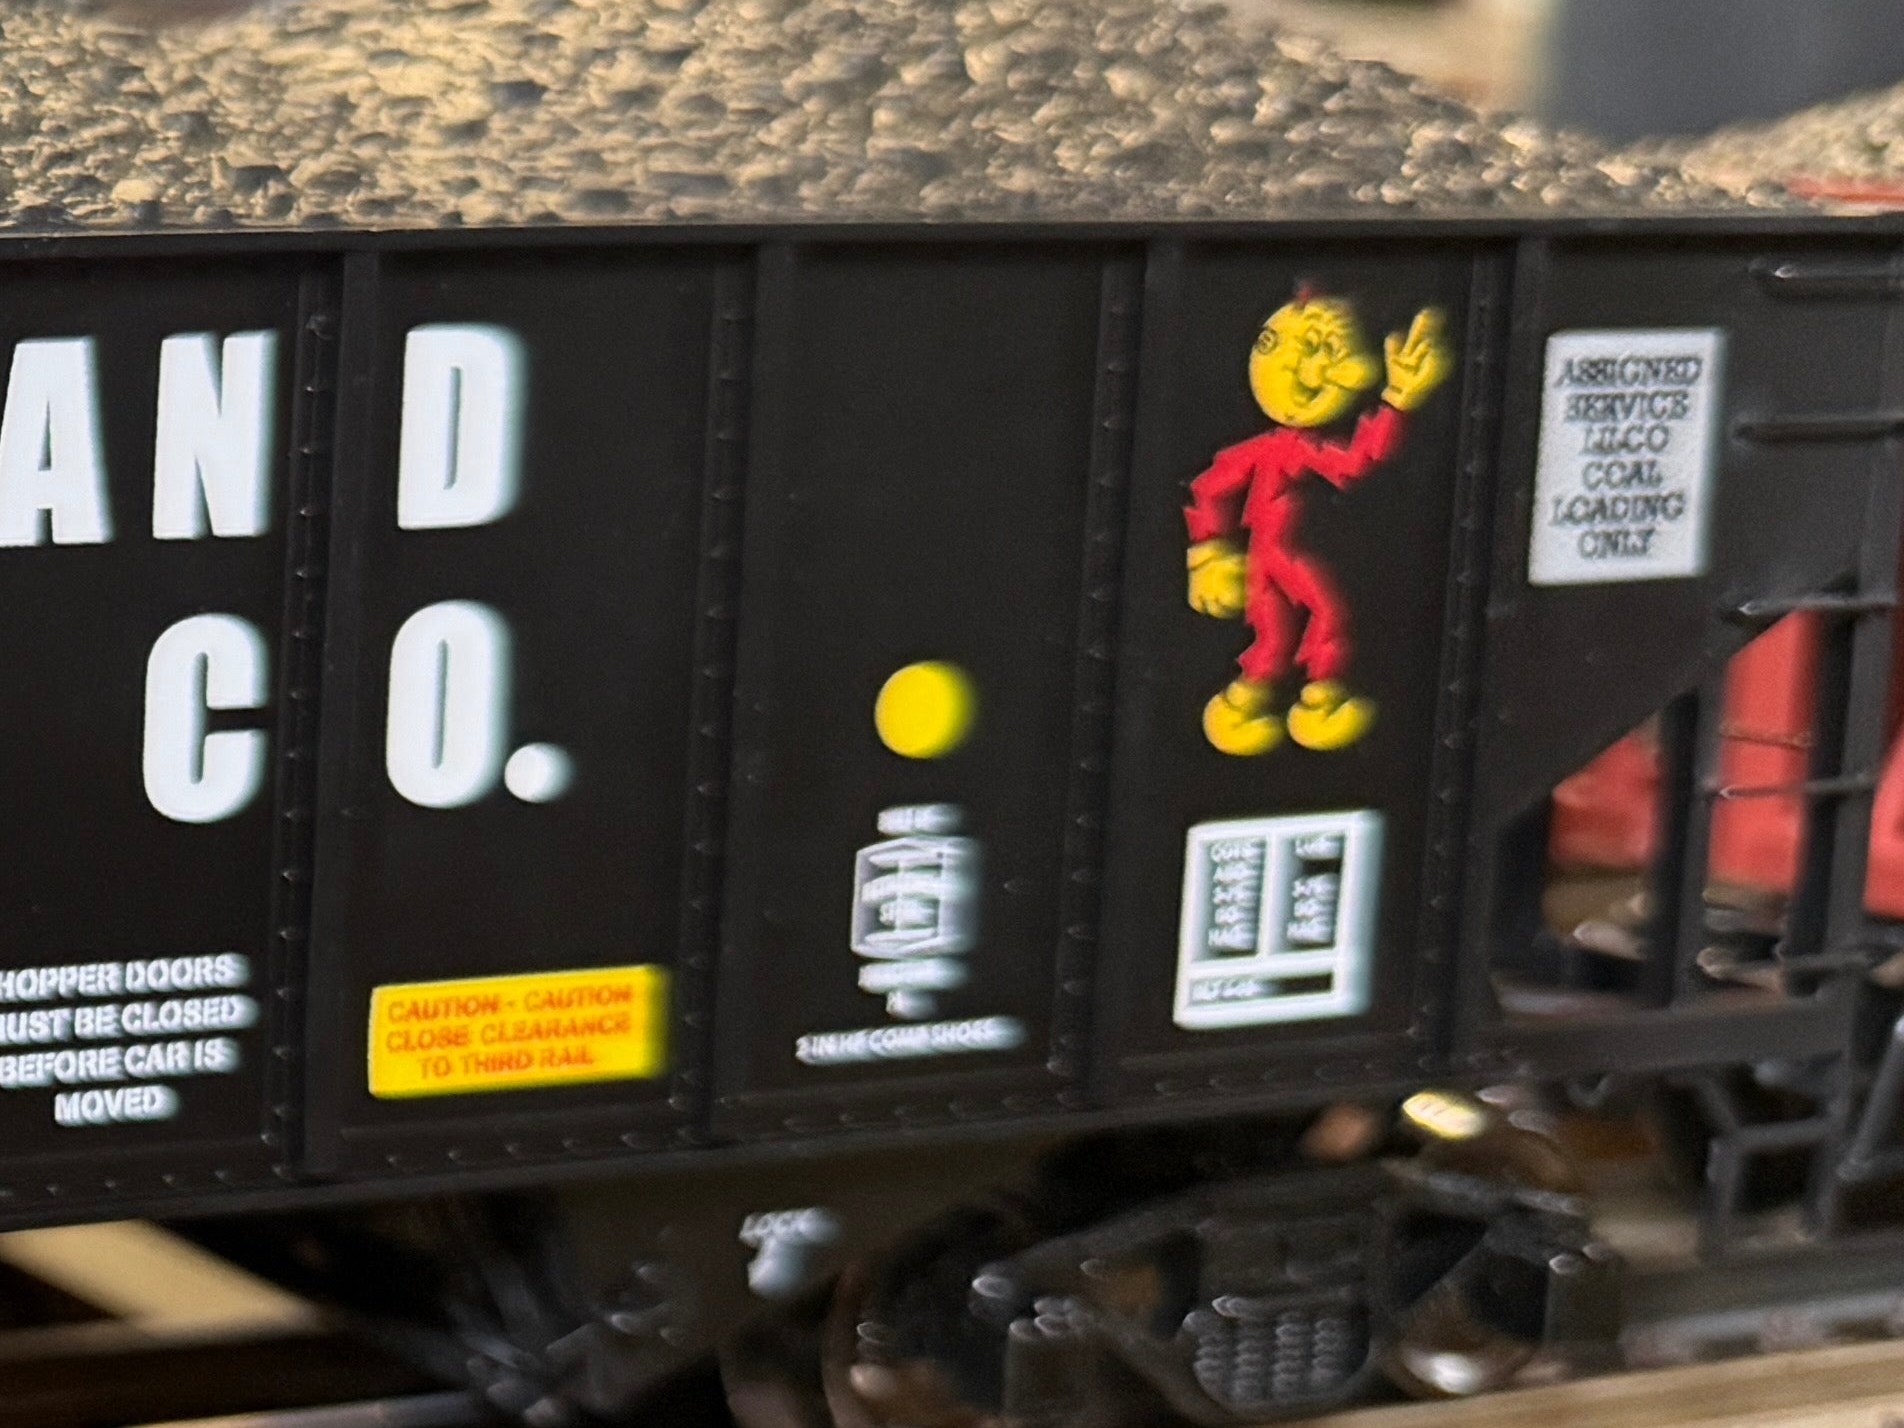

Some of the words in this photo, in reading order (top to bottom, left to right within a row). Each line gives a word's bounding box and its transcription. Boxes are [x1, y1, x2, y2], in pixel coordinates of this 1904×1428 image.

[1553, 356, 1703, 388] ASSIGNED
[1564, 391, 1689, 422] SERVICE
[1581, 459, 1662, 491] COAL
[1548, 492, 1685, 527] LOADING
[1576, 528, 1656, 560] ONLY
[125, 953, 249, 993] DOORS
[75, 1003, 123, 1039] BE
[122, 994, 257, 1035] CLOSED
[388, 993, 501, 1022] CAUTION
[523, 984, 632, 1012] CAUTION
[386, 1024, 469, 1053] CLOSE
[480, 1011, 632, 1046] CLEARANCE
[125, 1040, 191, 1078] CAR
[193, 1036, 239, 1072] IS
[418, 1055, 453, 1080] TO
[459, 1049, 534, 1075] THIRD
[55, 1084, 178, 1127] MOVED
